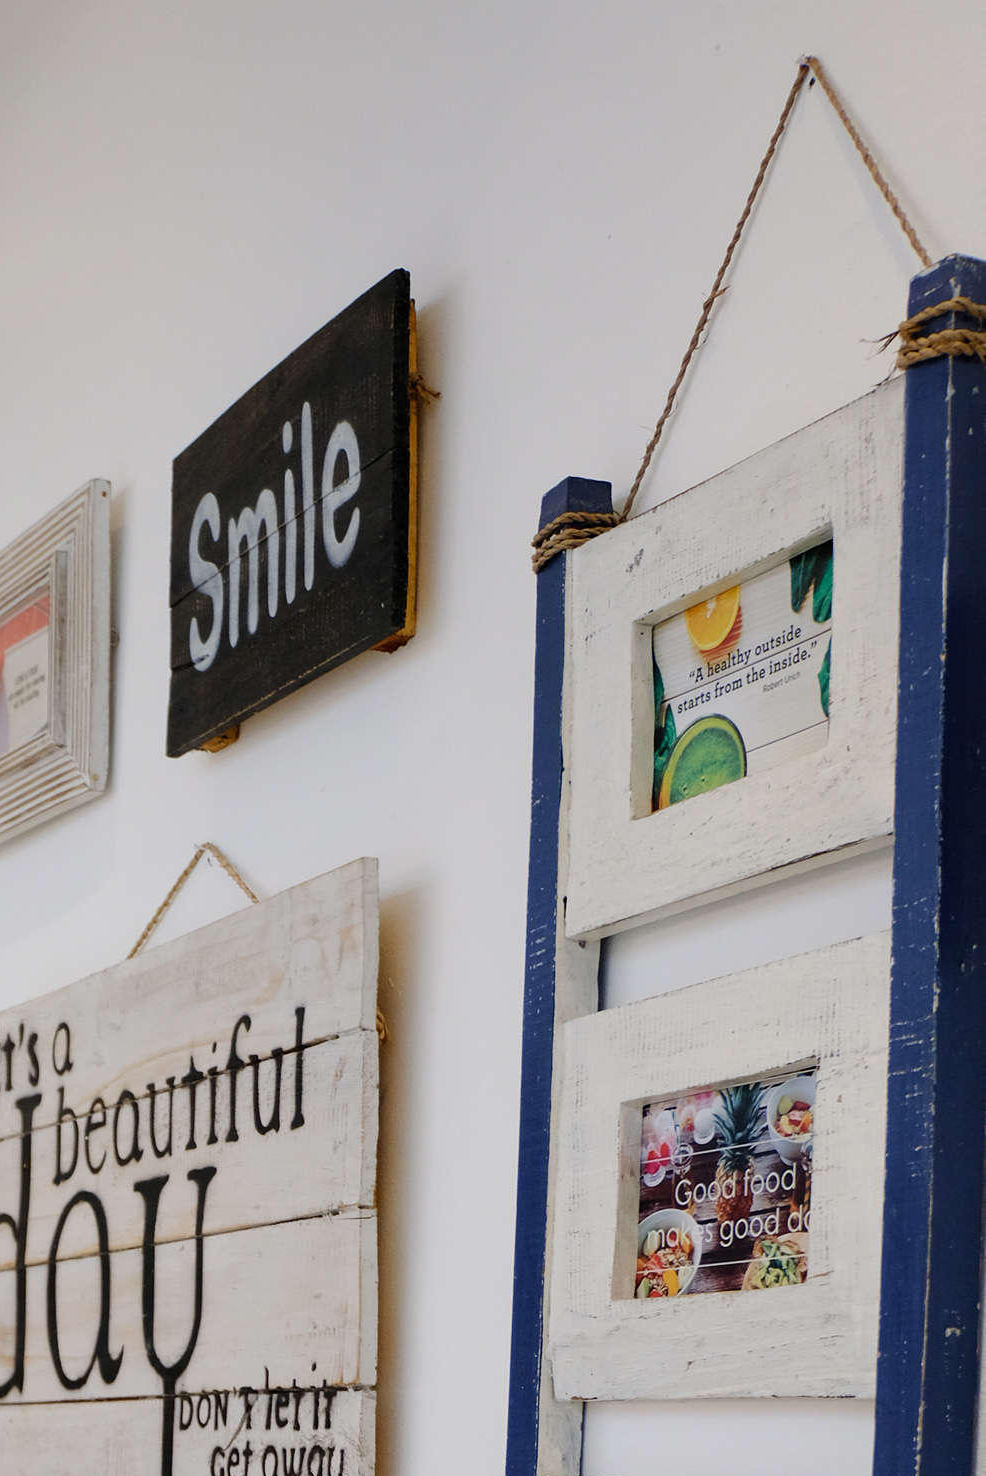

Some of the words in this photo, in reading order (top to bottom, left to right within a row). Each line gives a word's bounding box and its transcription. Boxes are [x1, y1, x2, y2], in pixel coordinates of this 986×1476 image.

[188, 400, 361, 673] Smile
[707, 649, 752, 678] healthy
[754, 624, 802, 656] outside
[677, 690, 711, 714] starts
[714, 678, 743, 699] from
[746, 667, 766, 685] the
[52, 1021, 74, 1077] a
[52, 1006, 306, 1187] beautiful
[675, 1171, 736, 1206] Good
[743, 1161, 797, 1197] food
[647, 1220, 714, 1250] makes
[719, 1207, 780, 1247] good
[264, 1366, 305, 1431] let
[311, 1362, 338, 1431] it
